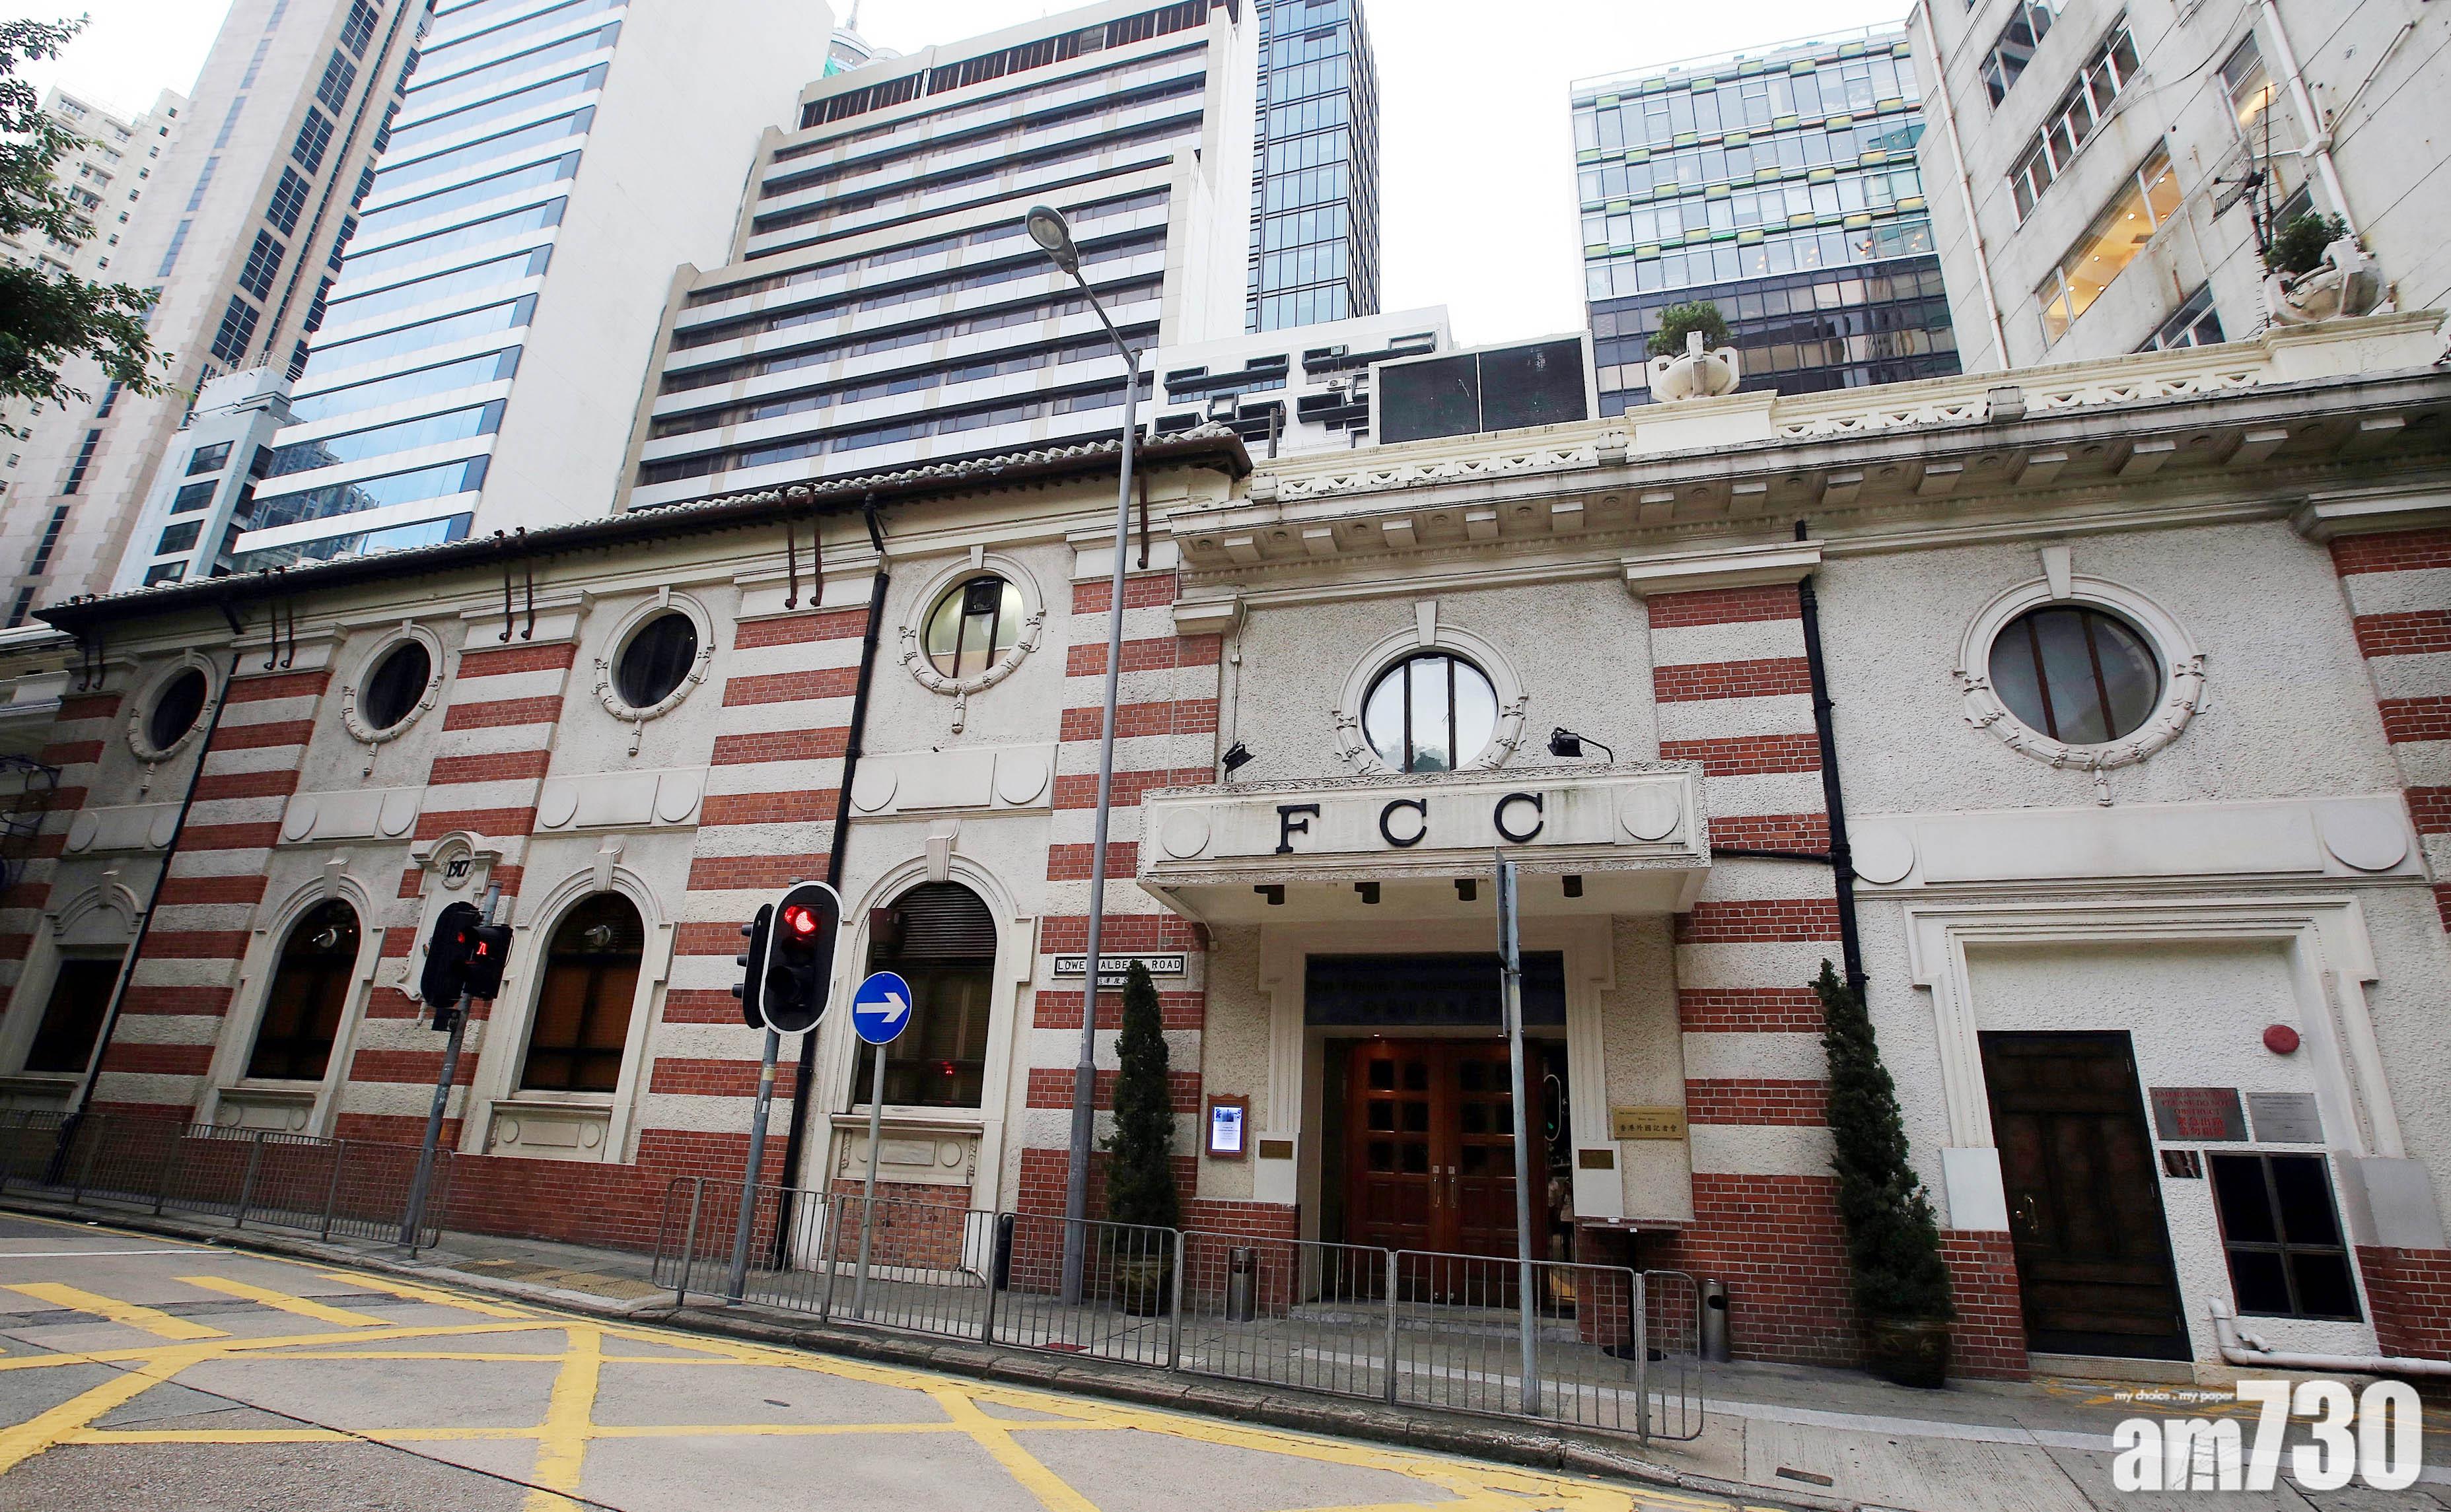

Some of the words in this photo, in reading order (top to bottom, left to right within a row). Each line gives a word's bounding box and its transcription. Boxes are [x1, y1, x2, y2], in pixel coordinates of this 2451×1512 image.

[446, 860, 470, 878] 1917
[1057, 961, 1085, 970] LOWE
[1100, 960, 1143, 969] ALBE
[1152, 959, 1181, 969] ROAD
